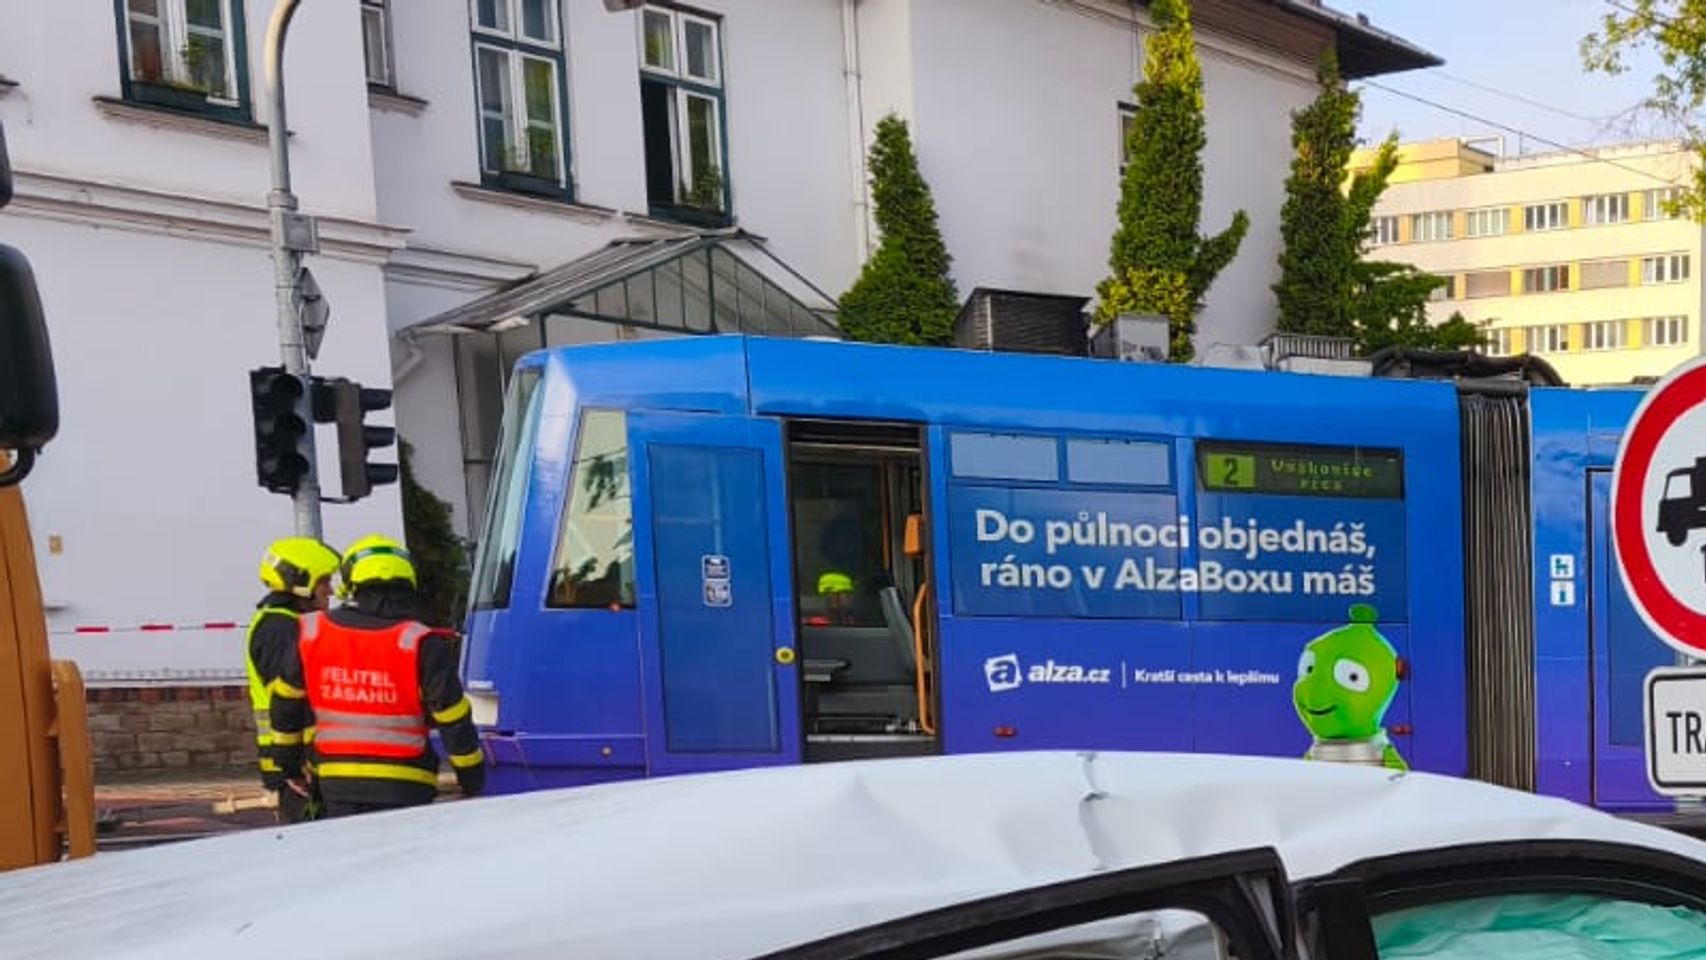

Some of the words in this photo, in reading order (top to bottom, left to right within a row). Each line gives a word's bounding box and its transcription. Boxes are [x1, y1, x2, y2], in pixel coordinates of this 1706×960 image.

[1223, 458, 1240, 485] 2
[976, 509, 1034, 543] Do
[1046, 511, 1189, 554] půlnoci
[1199, 517, 1376, 560] objednáš,
[981, 555, 1073, 588] ráno
[1081, 565, 1106, 589] v
[1115, 557, 1293, 593] AlzaBoxu
[1303, 565, 1376, 596] máš
[1028, 660, 1110, 683] alza.cz
[1216, 669, 1226, 682] k
